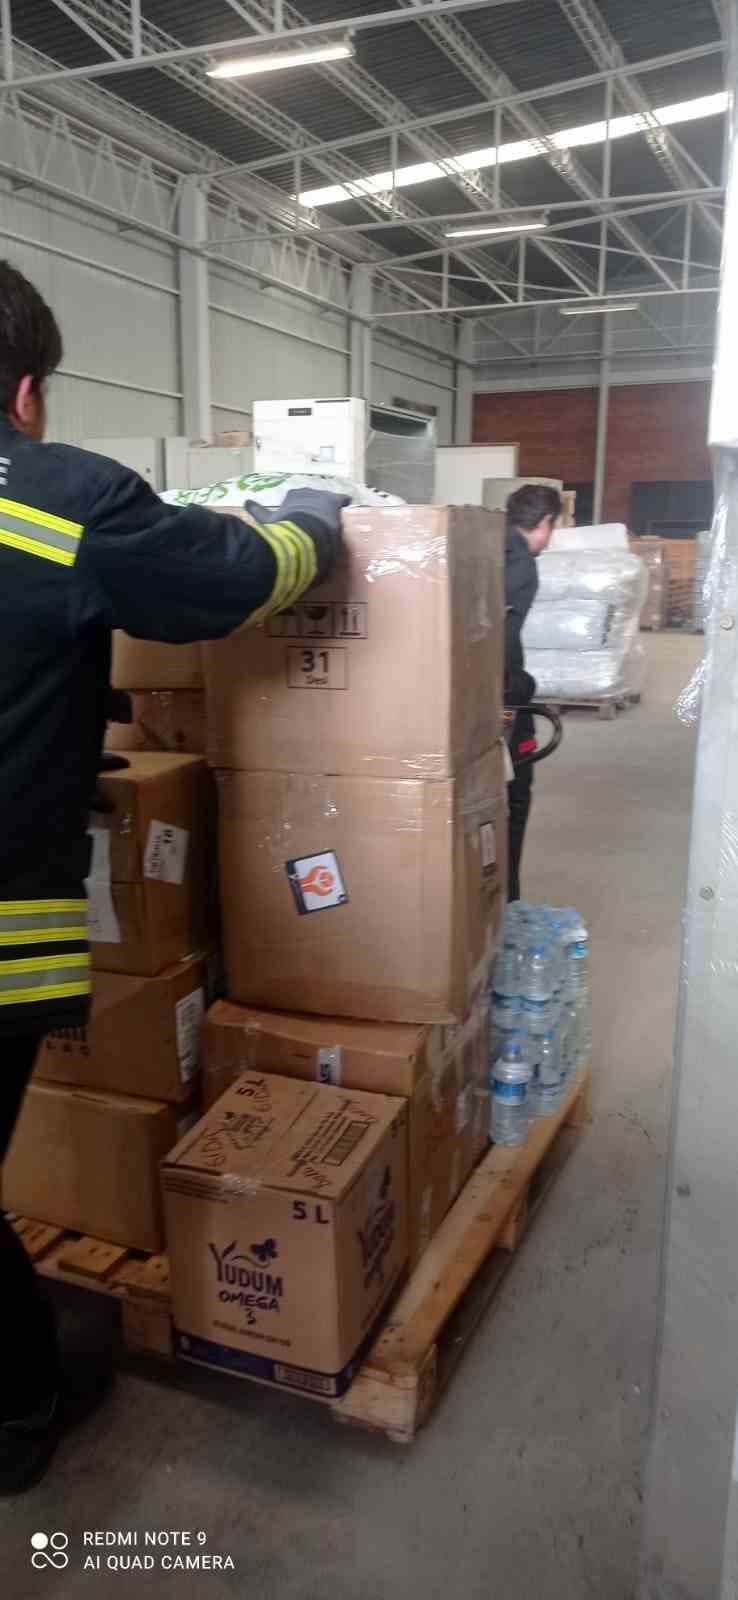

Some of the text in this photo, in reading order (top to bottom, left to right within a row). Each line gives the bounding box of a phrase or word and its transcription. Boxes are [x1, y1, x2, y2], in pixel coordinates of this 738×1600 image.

[301, 651, 329, 673] 31
[292, 1199, 330, 1225] 5 L
[218, 1289, 280, 1313] OMEGA
